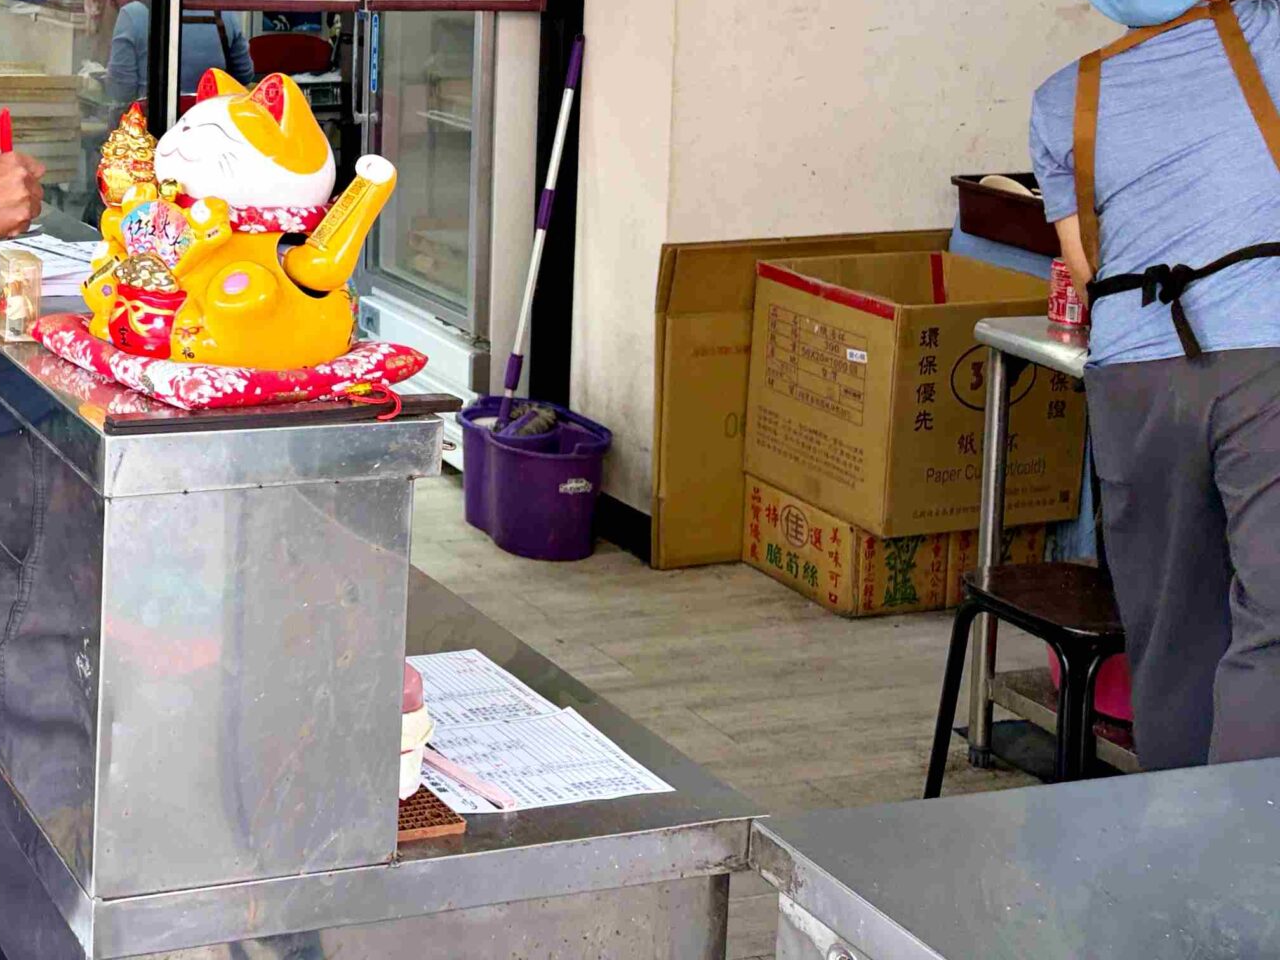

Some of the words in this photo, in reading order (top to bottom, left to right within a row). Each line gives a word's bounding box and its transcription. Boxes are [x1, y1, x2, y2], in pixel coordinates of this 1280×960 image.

[914, 327, 940, 432] 環保優先
[926, 467, 961, 486] Paper
[964, 463, 982, 481] Cu
